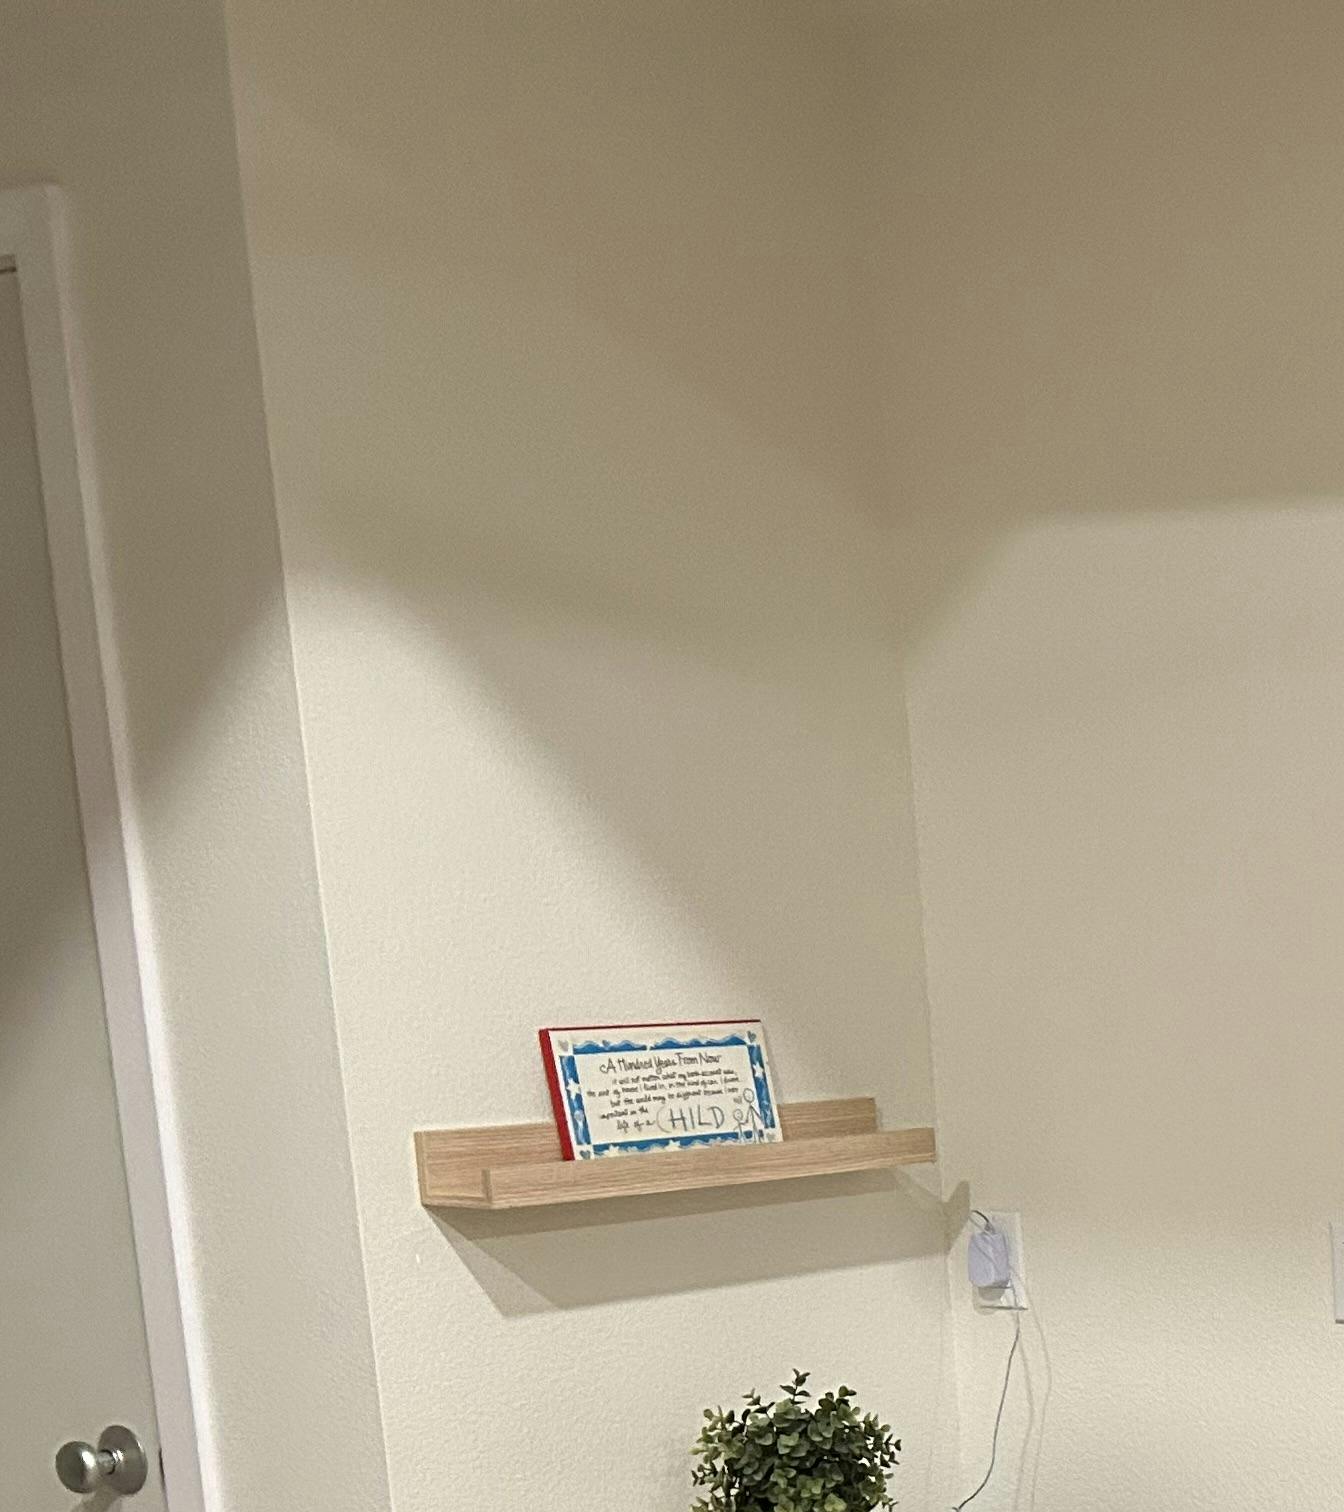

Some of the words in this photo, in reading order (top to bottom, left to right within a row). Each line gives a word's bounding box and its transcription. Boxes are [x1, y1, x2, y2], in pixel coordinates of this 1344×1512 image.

[600, 1058, 616, 1073] A
[618, 1056, 653, 1072] Hundred
[654, 1055, 678, 1074] Years
[675, 1052, 699, 1066] From
[700, 1052, 722, 1066] Now
[657, 1104, 725, 1133] CHILD
